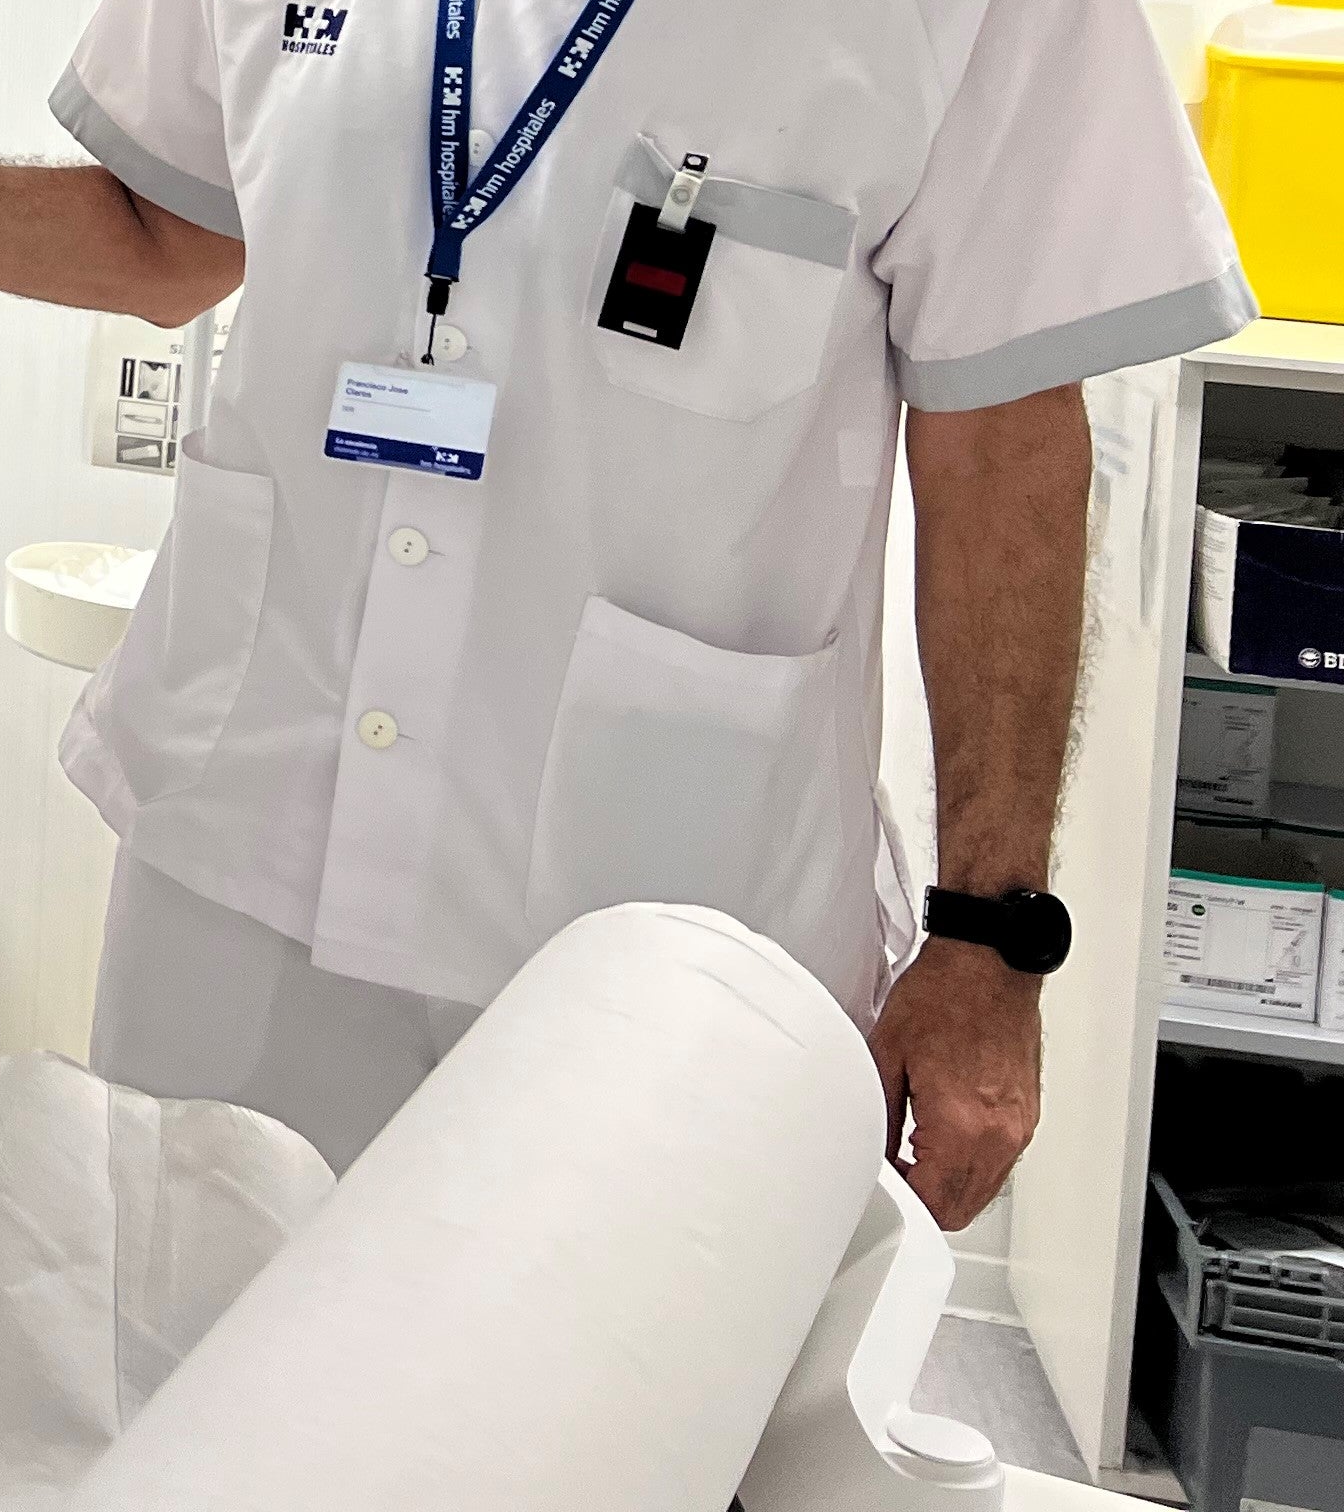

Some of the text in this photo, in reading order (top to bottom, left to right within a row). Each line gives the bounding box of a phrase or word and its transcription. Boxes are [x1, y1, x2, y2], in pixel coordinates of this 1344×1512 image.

[581, 12, 611, 40] hm
[281, 39, 337, 56] HOSPITALES
[441, 109, 461, 137] hm
[476, 173, 506, 199] hm
[494, 97, 556, 174] hospitales
[437, 140, 460, 222] hospitale
